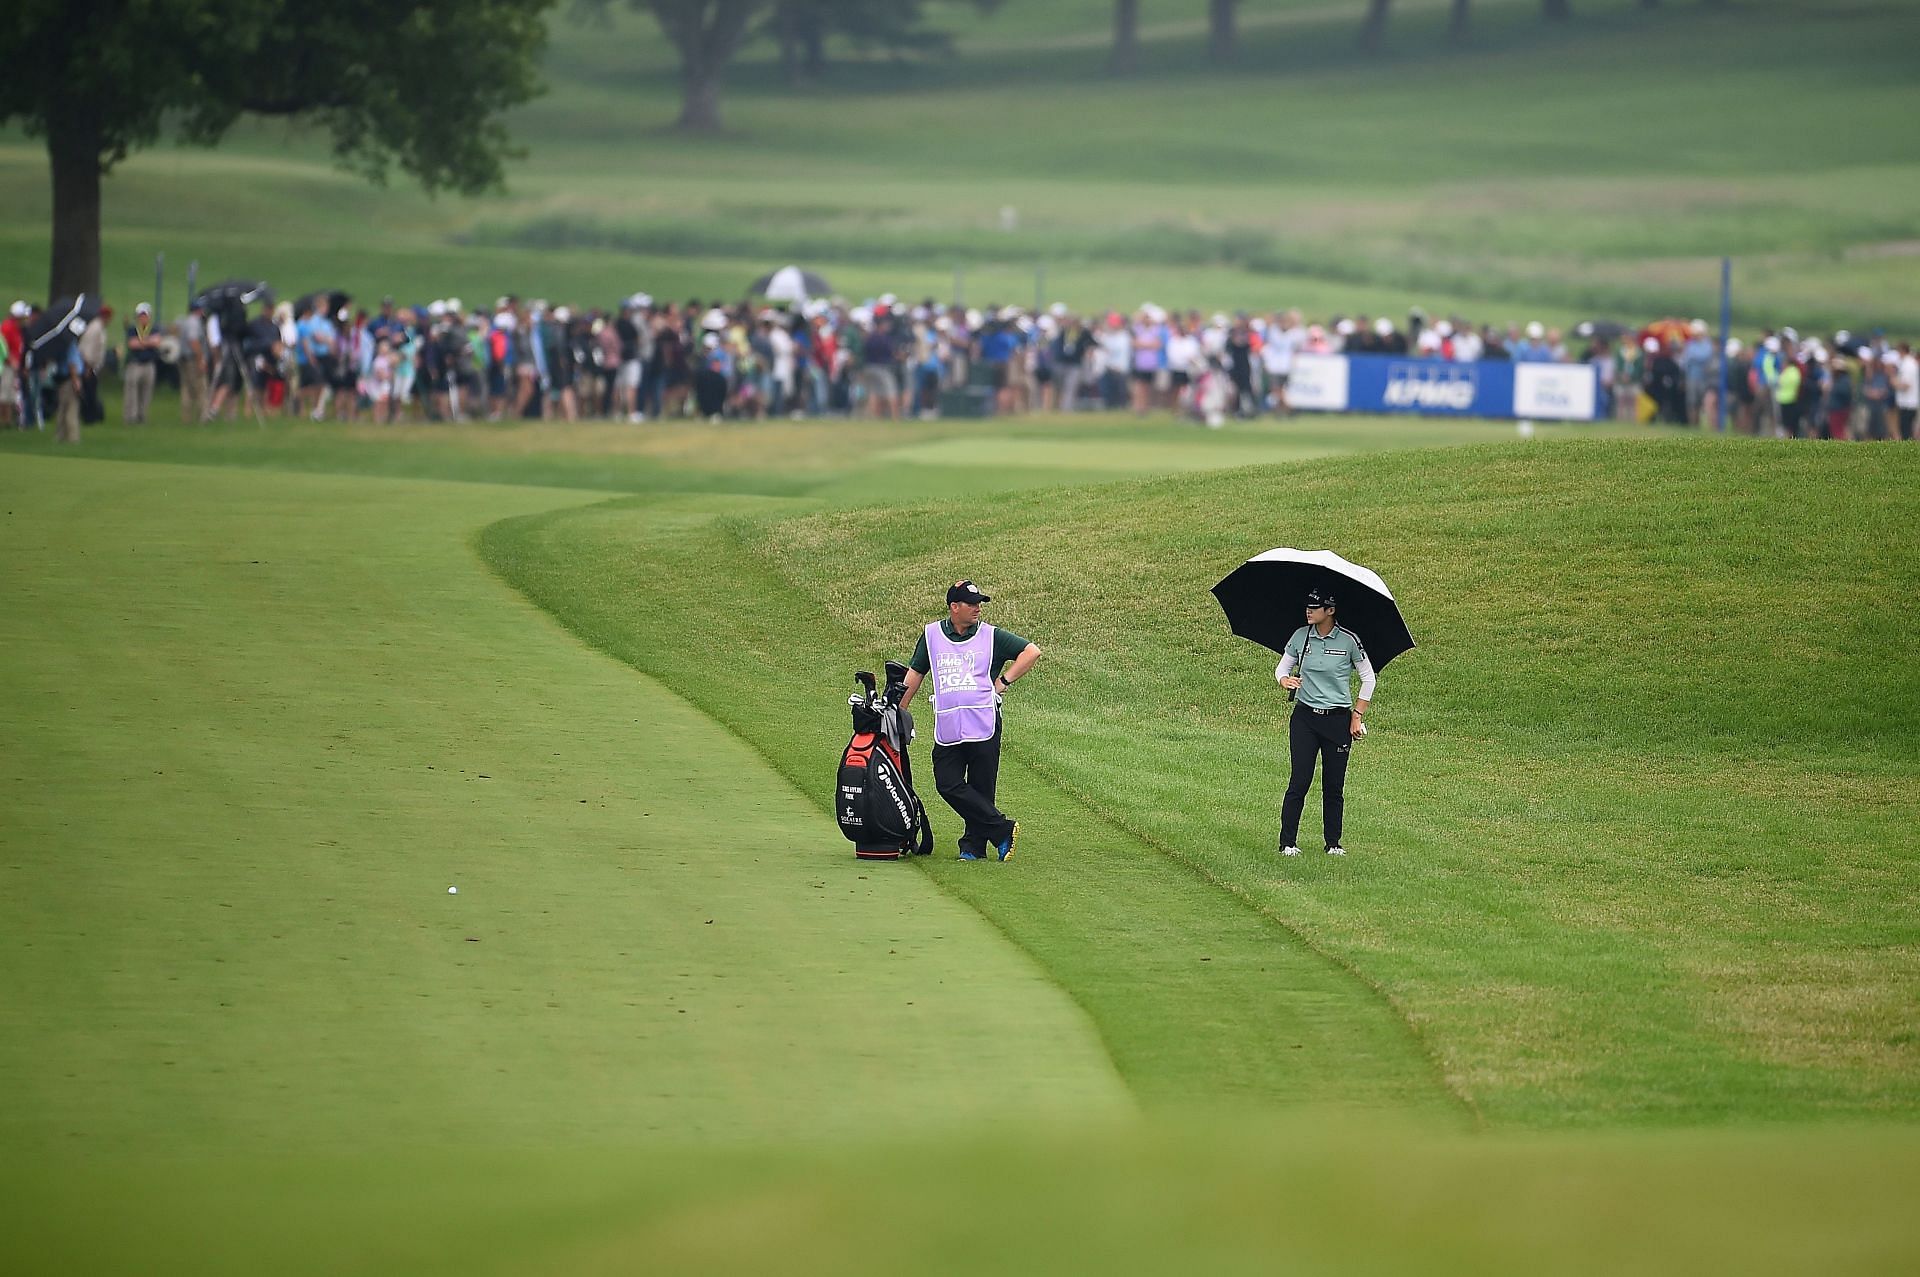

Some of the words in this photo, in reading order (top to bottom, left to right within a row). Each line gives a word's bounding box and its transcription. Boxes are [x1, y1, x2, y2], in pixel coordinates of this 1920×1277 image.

[1383, 379, 1475, 408] KPMG
[937, 658, 963, 668] KPMG
[939, 672, 977, 688] PGA
[877, 762, 912, 830] TaylorMade
